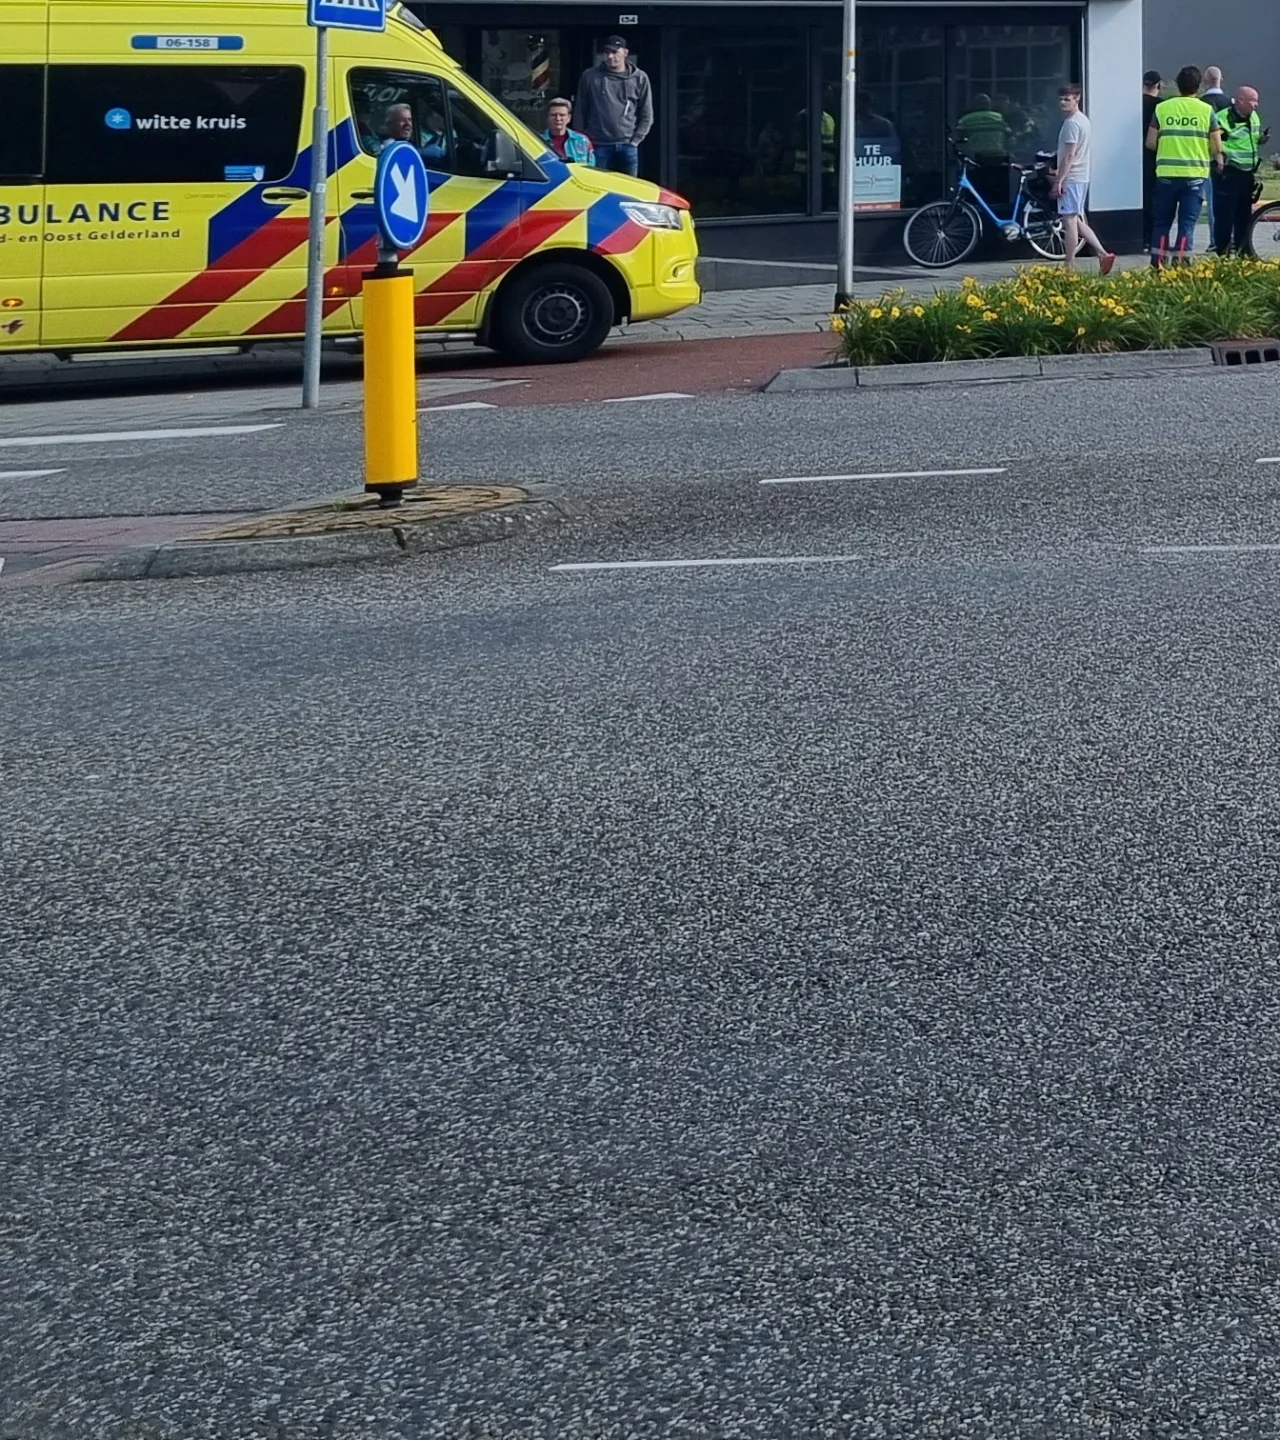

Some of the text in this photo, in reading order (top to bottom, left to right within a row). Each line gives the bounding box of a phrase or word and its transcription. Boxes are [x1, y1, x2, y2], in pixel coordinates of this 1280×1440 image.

[166, 38, 211, 47] 06-158
[136, 113, 247, 129] witte kruis
[1166, 116, 1198, 127] OvDG
[864, 144, 881, 155] TE
[854, 156, 892, 166] HUUR
[19, 234, 38, 242] en
[43, 231, 82, 242] Oost
[88, 229, 180, 240] Gelderland
